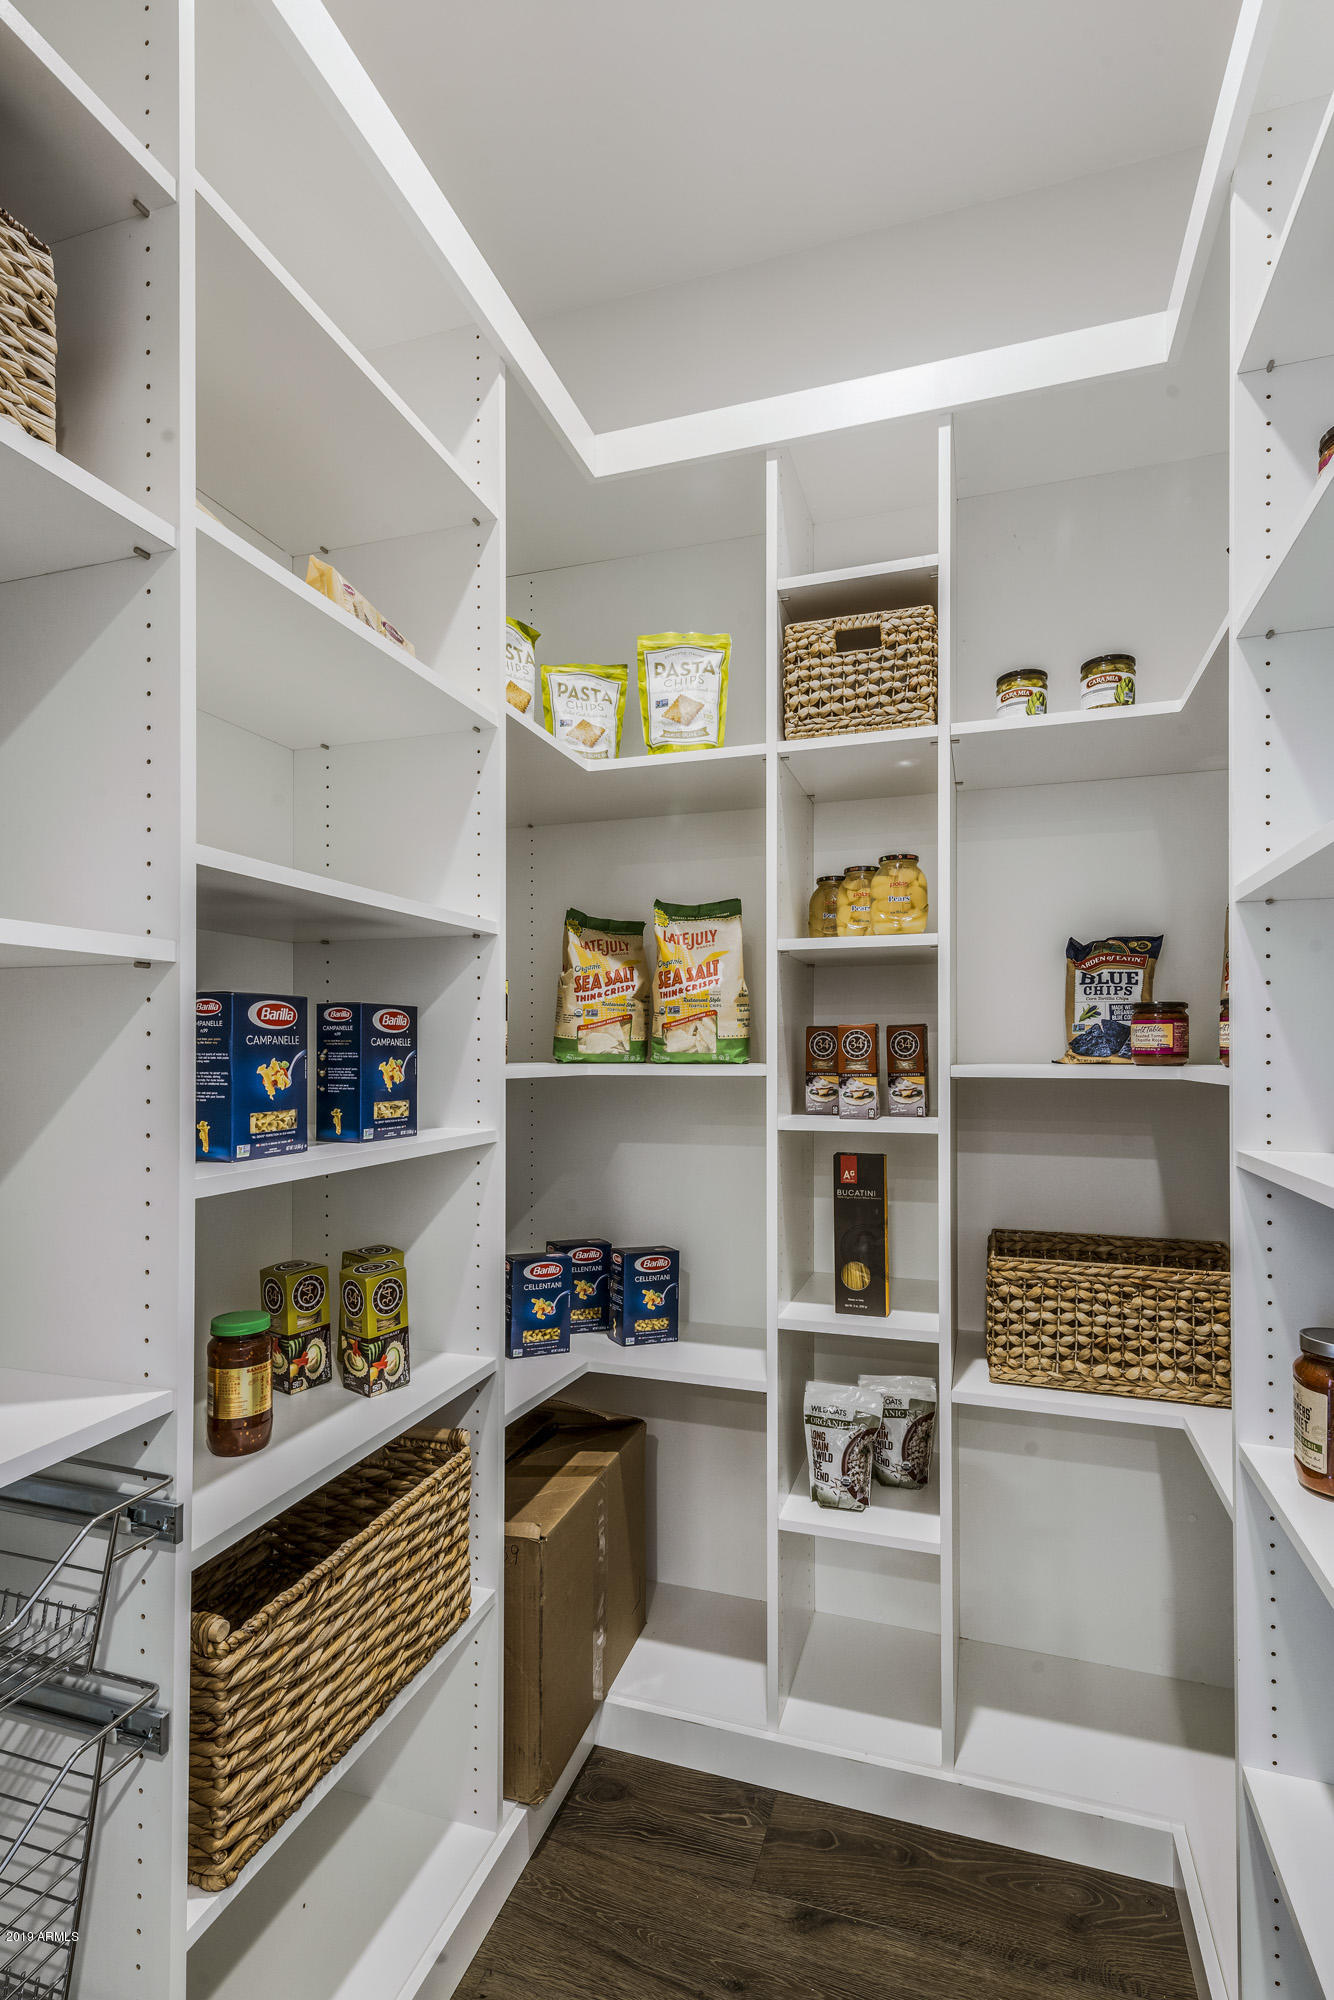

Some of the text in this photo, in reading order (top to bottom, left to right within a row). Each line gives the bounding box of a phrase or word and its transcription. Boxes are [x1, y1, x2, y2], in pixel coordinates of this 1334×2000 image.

[506, 643, 535, 664] STA
[653, 660, 716, 678] PASTA
[663, 674, 705, 689] CHIPS
[1088, 677, 1106, 686] CARA
[557, 682, 613, 705] PASTA
[566, 700, 604, 712] CHIPS
[664, 929, 718, 950] LATE JULY
[580, 939, 629, 956] LATE JULY
[575, 963, 601, 973] Organic
[1080, 956, 1106, 969] ARDEN
[574, 967, 635, 993] SEA SALT
[658, 960, 719, 989] SEA SALT
[1079, 971, 1138, 985] BLUE
[576, 990, 597, 1002] THIN
[604, 984, 636, 997] CRISPY
[660, 989, 677, 999] THIN
[684, 977, 720, 993] CRISPY
[1083, 985, 1133, 996] CHIPS
[260, 1007, 294, 1021] Barilla
[330, 1010, 350, 1018] Barilla
[382, 1014, 408, 1026] Barilla
[246, 1035, 300, 1045] CAMPANELLE
[370, 1038, 411, 1046] CAMPANELLE
[836, 1189, 876, 1197] BUCATINI
[575, 1251, 600, 1259] Barilla
[643, 1259, 668, 1268] Barilla
[533, 1266, 560, 1275] Barilla
[634, 1274, 671, 1282] CELLENTANI
[524, 1282, 562, 1291] CELLENTANI
[811, 1405, 828, 1413] WILD
[883, 1409, 905, 1417] ANIC
[816, 1450, 834, 1463] WILD
[875, 1453, 890, 1467] LEND
